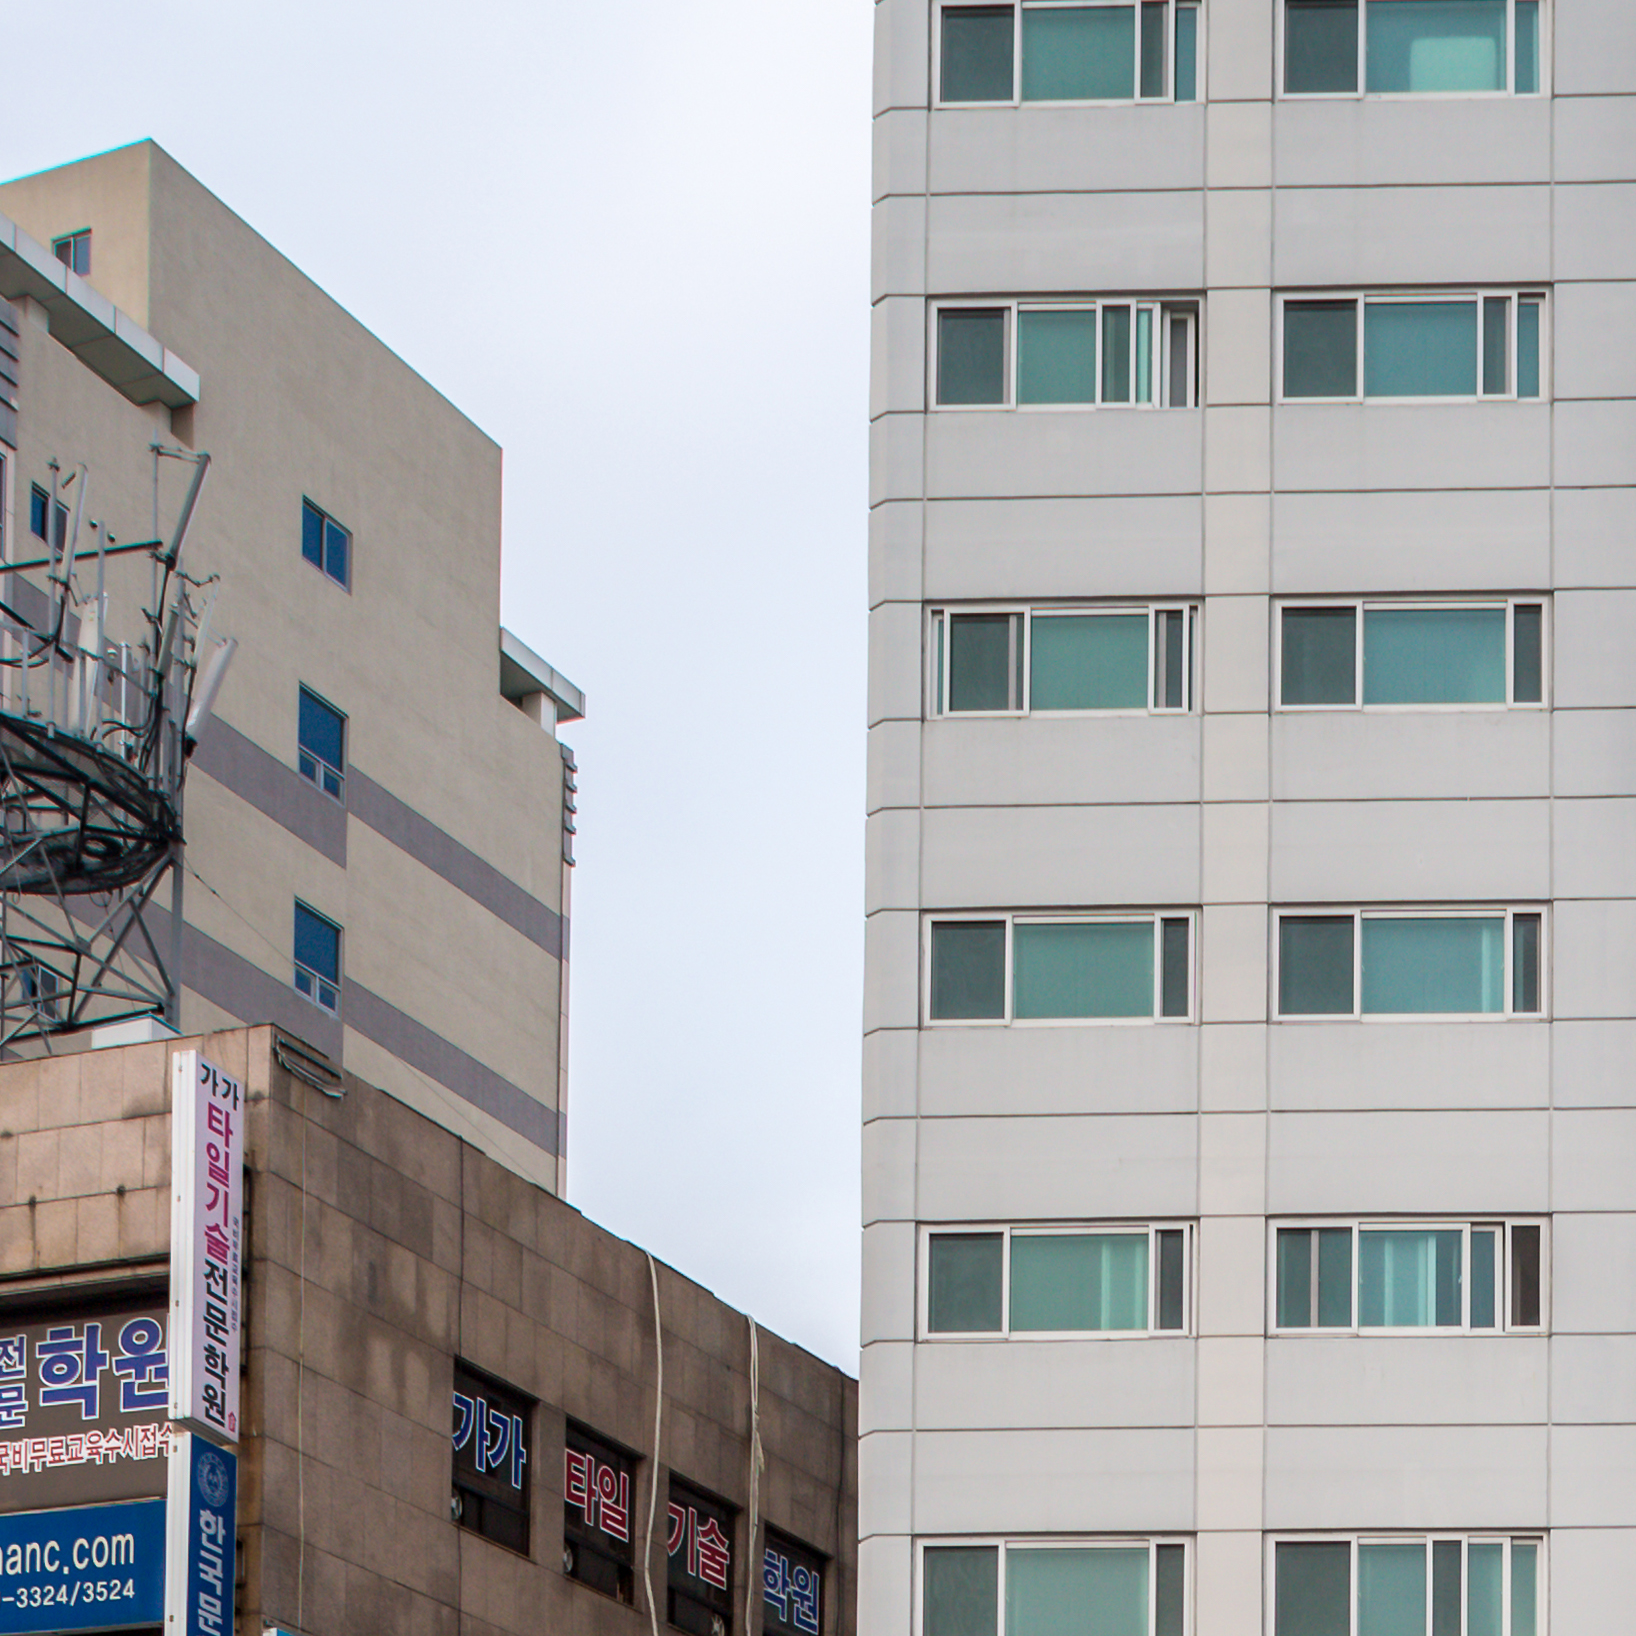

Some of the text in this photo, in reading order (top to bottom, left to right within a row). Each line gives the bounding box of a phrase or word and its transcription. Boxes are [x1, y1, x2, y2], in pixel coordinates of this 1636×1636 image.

[200, 1063, 239, 1111] 가가
[452, 1391, 820, 1636] 가가 타일 기술 학원
[0, 1532, 135, 1578] anc.com
